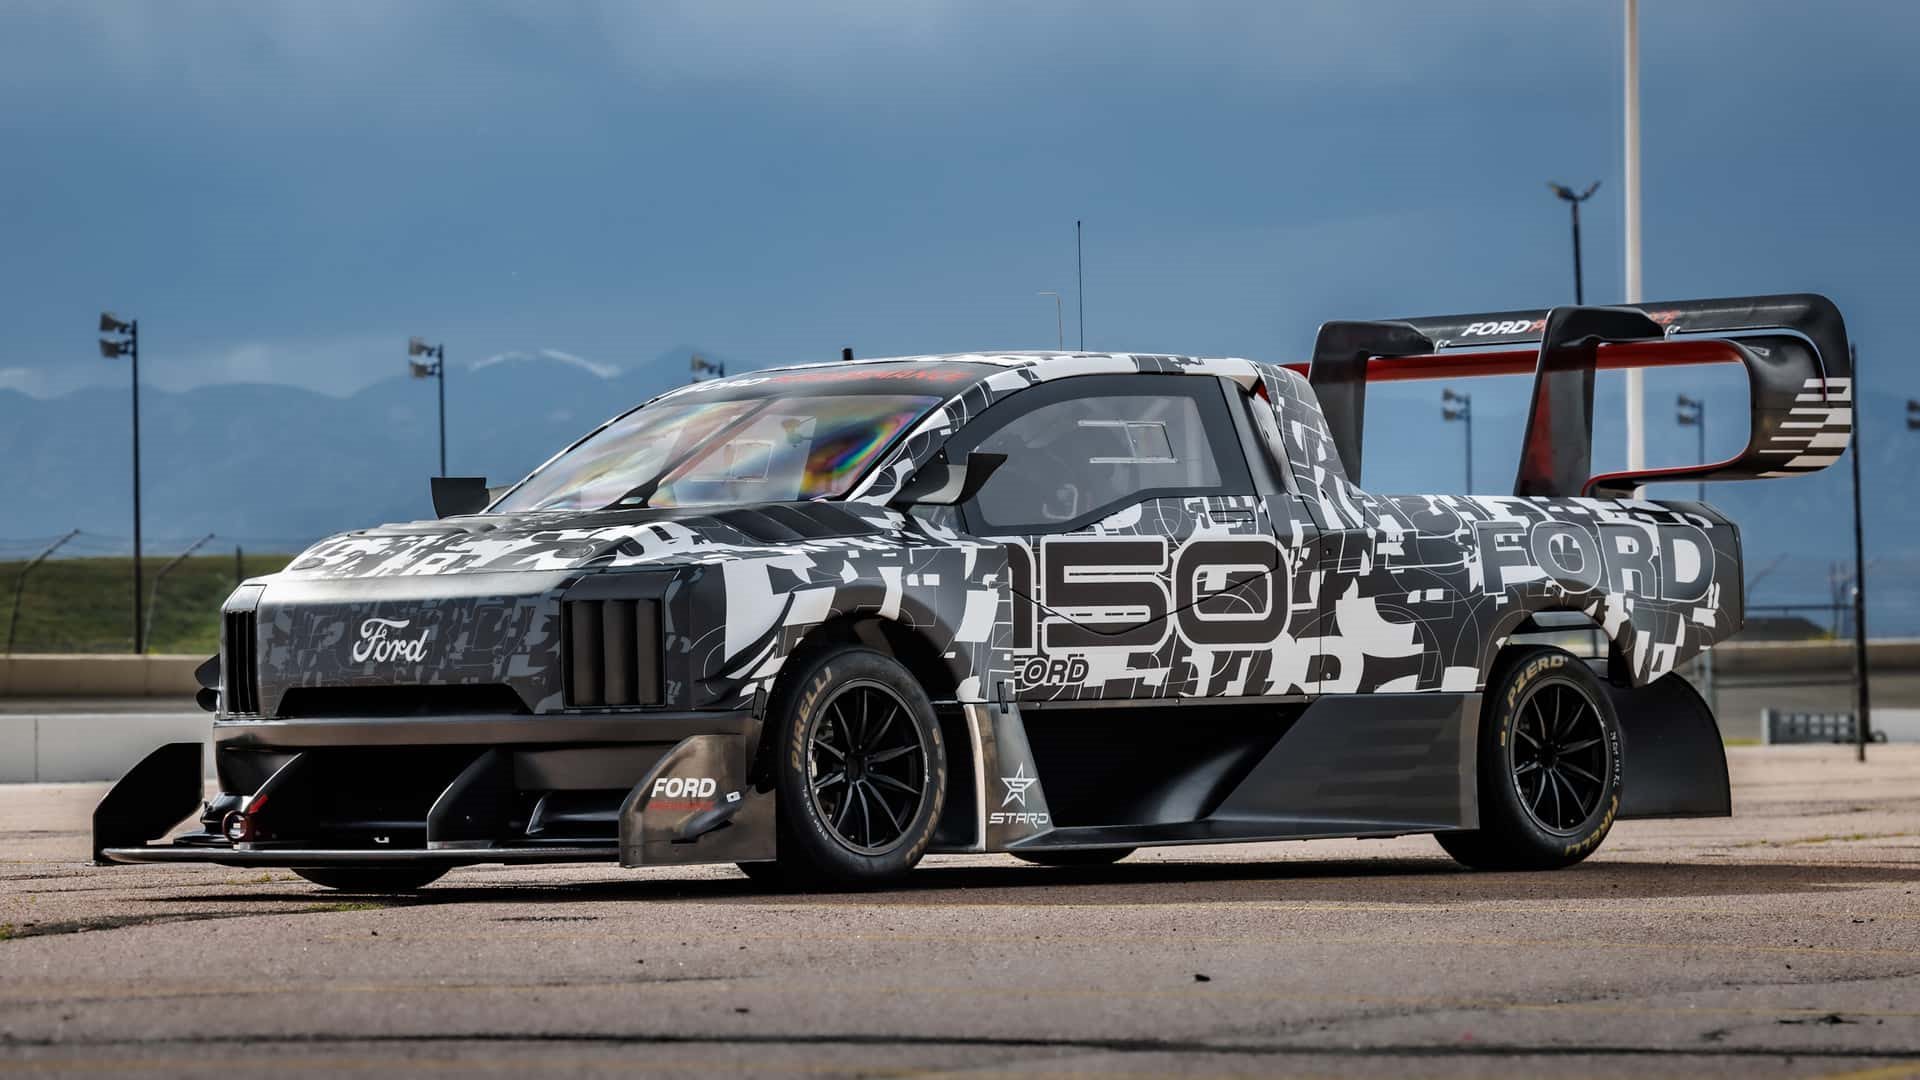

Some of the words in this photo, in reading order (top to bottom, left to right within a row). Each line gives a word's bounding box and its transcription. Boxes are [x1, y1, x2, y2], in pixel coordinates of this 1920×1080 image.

[1461, 320, 1530, 337] FORD
[1474, 520, 1716, 603] FORD
[352, 617, 430, 663] Ford
[790, 666, 832, 773] PIRELLI
[650, 777, 718, 798] FORD
[988, 811, 1050, 830] STARD
[1563, 794, 1620, 857] PIRELLI
